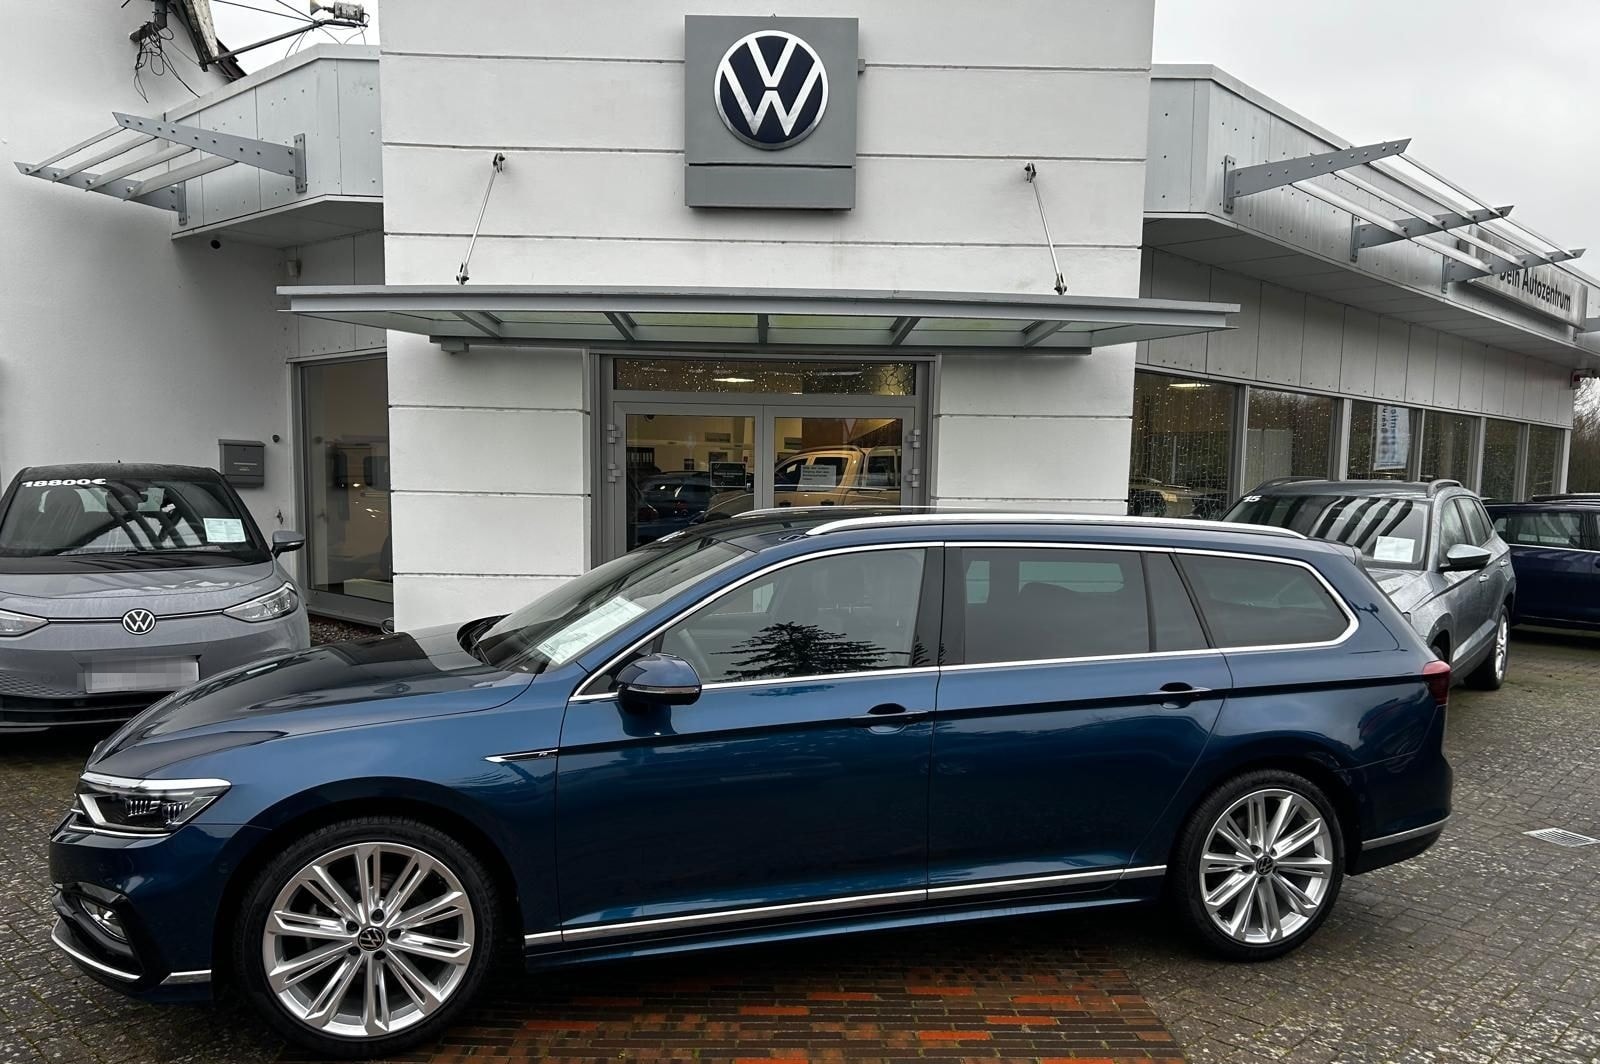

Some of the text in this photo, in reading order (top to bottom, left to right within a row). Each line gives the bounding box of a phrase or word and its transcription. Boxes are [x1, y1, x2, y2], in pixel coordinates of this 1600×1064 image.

[714, 30, 828, 150] VW
[1522, 268, 1571, 312] Autozentrum
[22, 478, 107, 488] 18800€
[123, 609, 155, 634] VW
